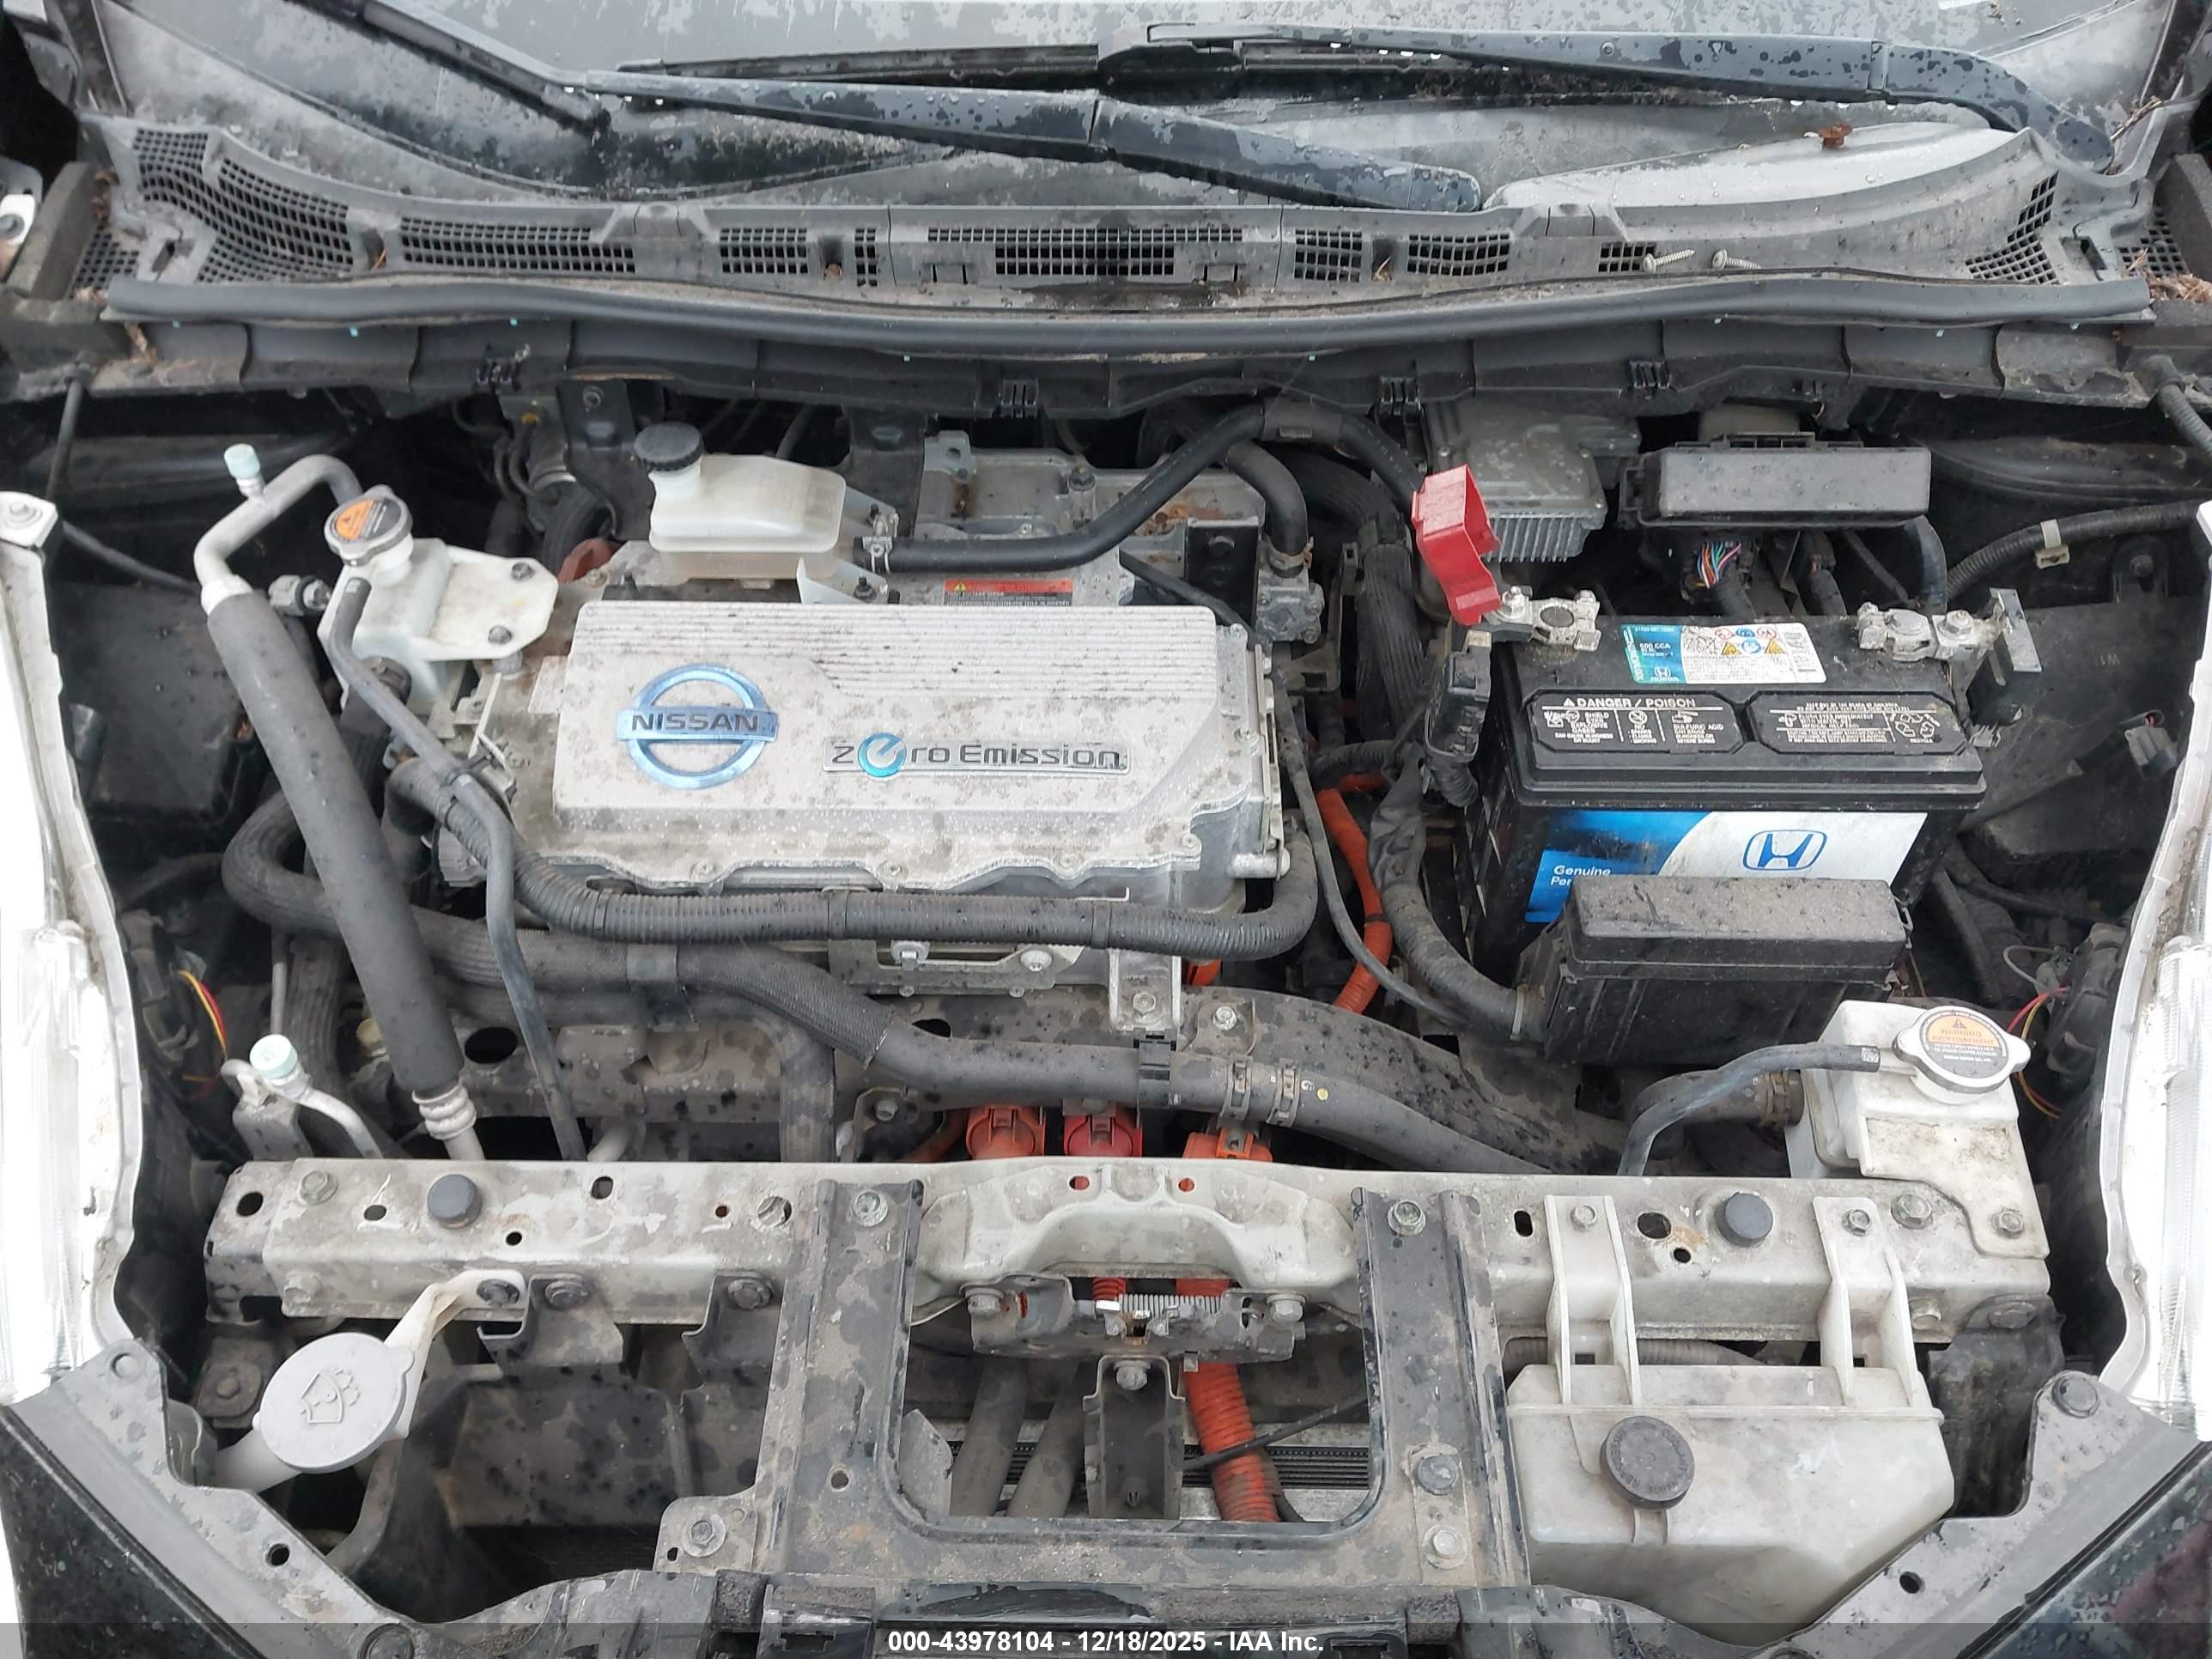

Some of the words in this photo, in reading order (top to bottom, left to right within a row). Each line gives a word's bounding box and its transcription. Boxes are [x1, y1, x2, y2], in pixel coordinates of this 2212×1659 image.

[1577, 698, 1632, 708] DANGER
[1634, 698, 1642, 708] /
[1645, 698, 1696, 708] POISON
[632, 714, 758, 732] NISSAN
[960, 743, 1121, 768] Emission
[1553, 865, 1611, 876] Genuine
[1551, 876, 1572, 885] Per
